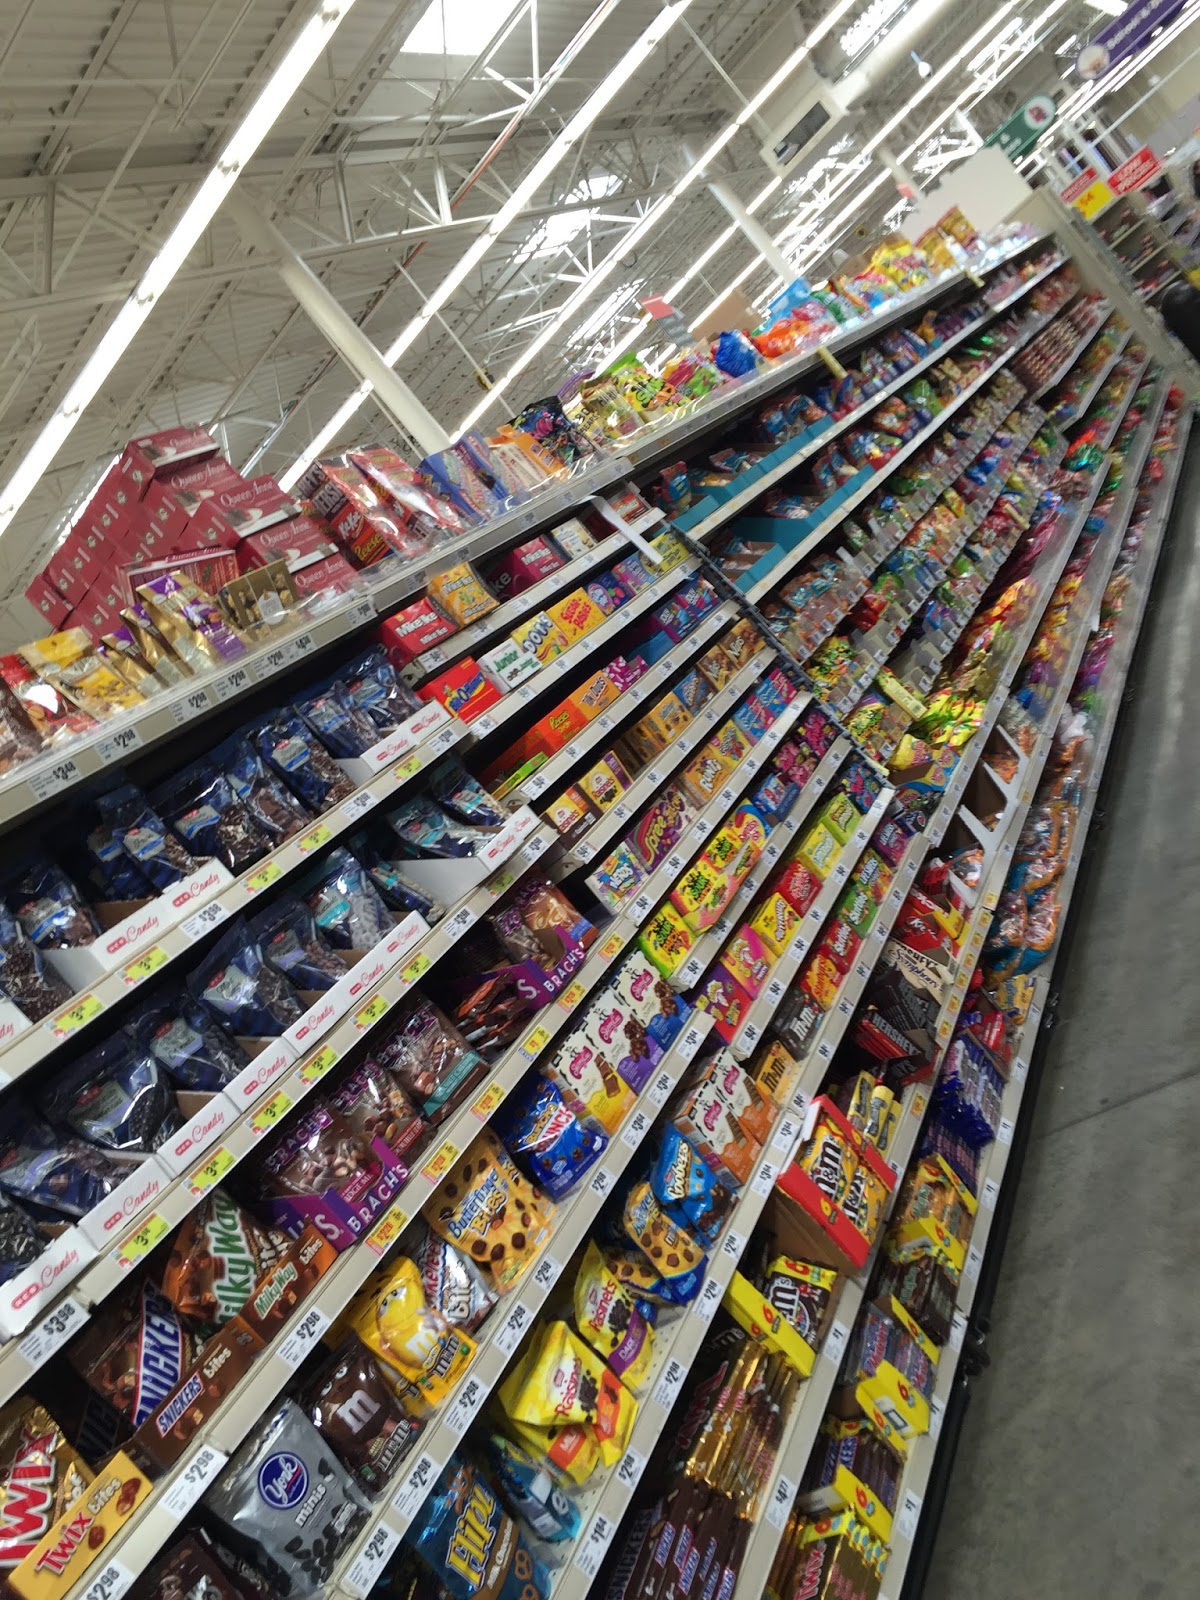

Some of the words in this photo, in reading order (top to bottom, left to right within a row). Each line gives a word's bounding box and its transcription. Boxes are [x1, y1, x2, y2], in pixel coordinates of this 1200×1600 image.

[220, 488, 249, 507] Queen
[247, 479, 274, 500] Anne
[260, 528, 289, 547] Queen
[286, 519, 310, 540] Anne
[522, 611, 555, 655] DOTS
[190, 871, 221, 900] Candy
[126, 914, 160, 944] Candy
[361, 962, 386, 987] Candy
[543, 940, 586, 993] BRACH'S
[308, 1003, 335, 1031] Candy
[257, 1054, 287, 1084] Candy
[191, 1108, 226, 1145] Candy
[667, 1140, 690, 1200] Goobers
[122, 1180, 160, 1216] Candy
[347, 1163, 410, 1233] BRACH'S
[39, 1247, 80, 1289] Candy
[202, 1346, 233, 1380] bites
[156, 1376, 203, 1437] SNICKERS
[87, 1477, 122, 1514] bites
[264, 1455, 301, 1506] York
[294, 1483, 328, 1528] minis
